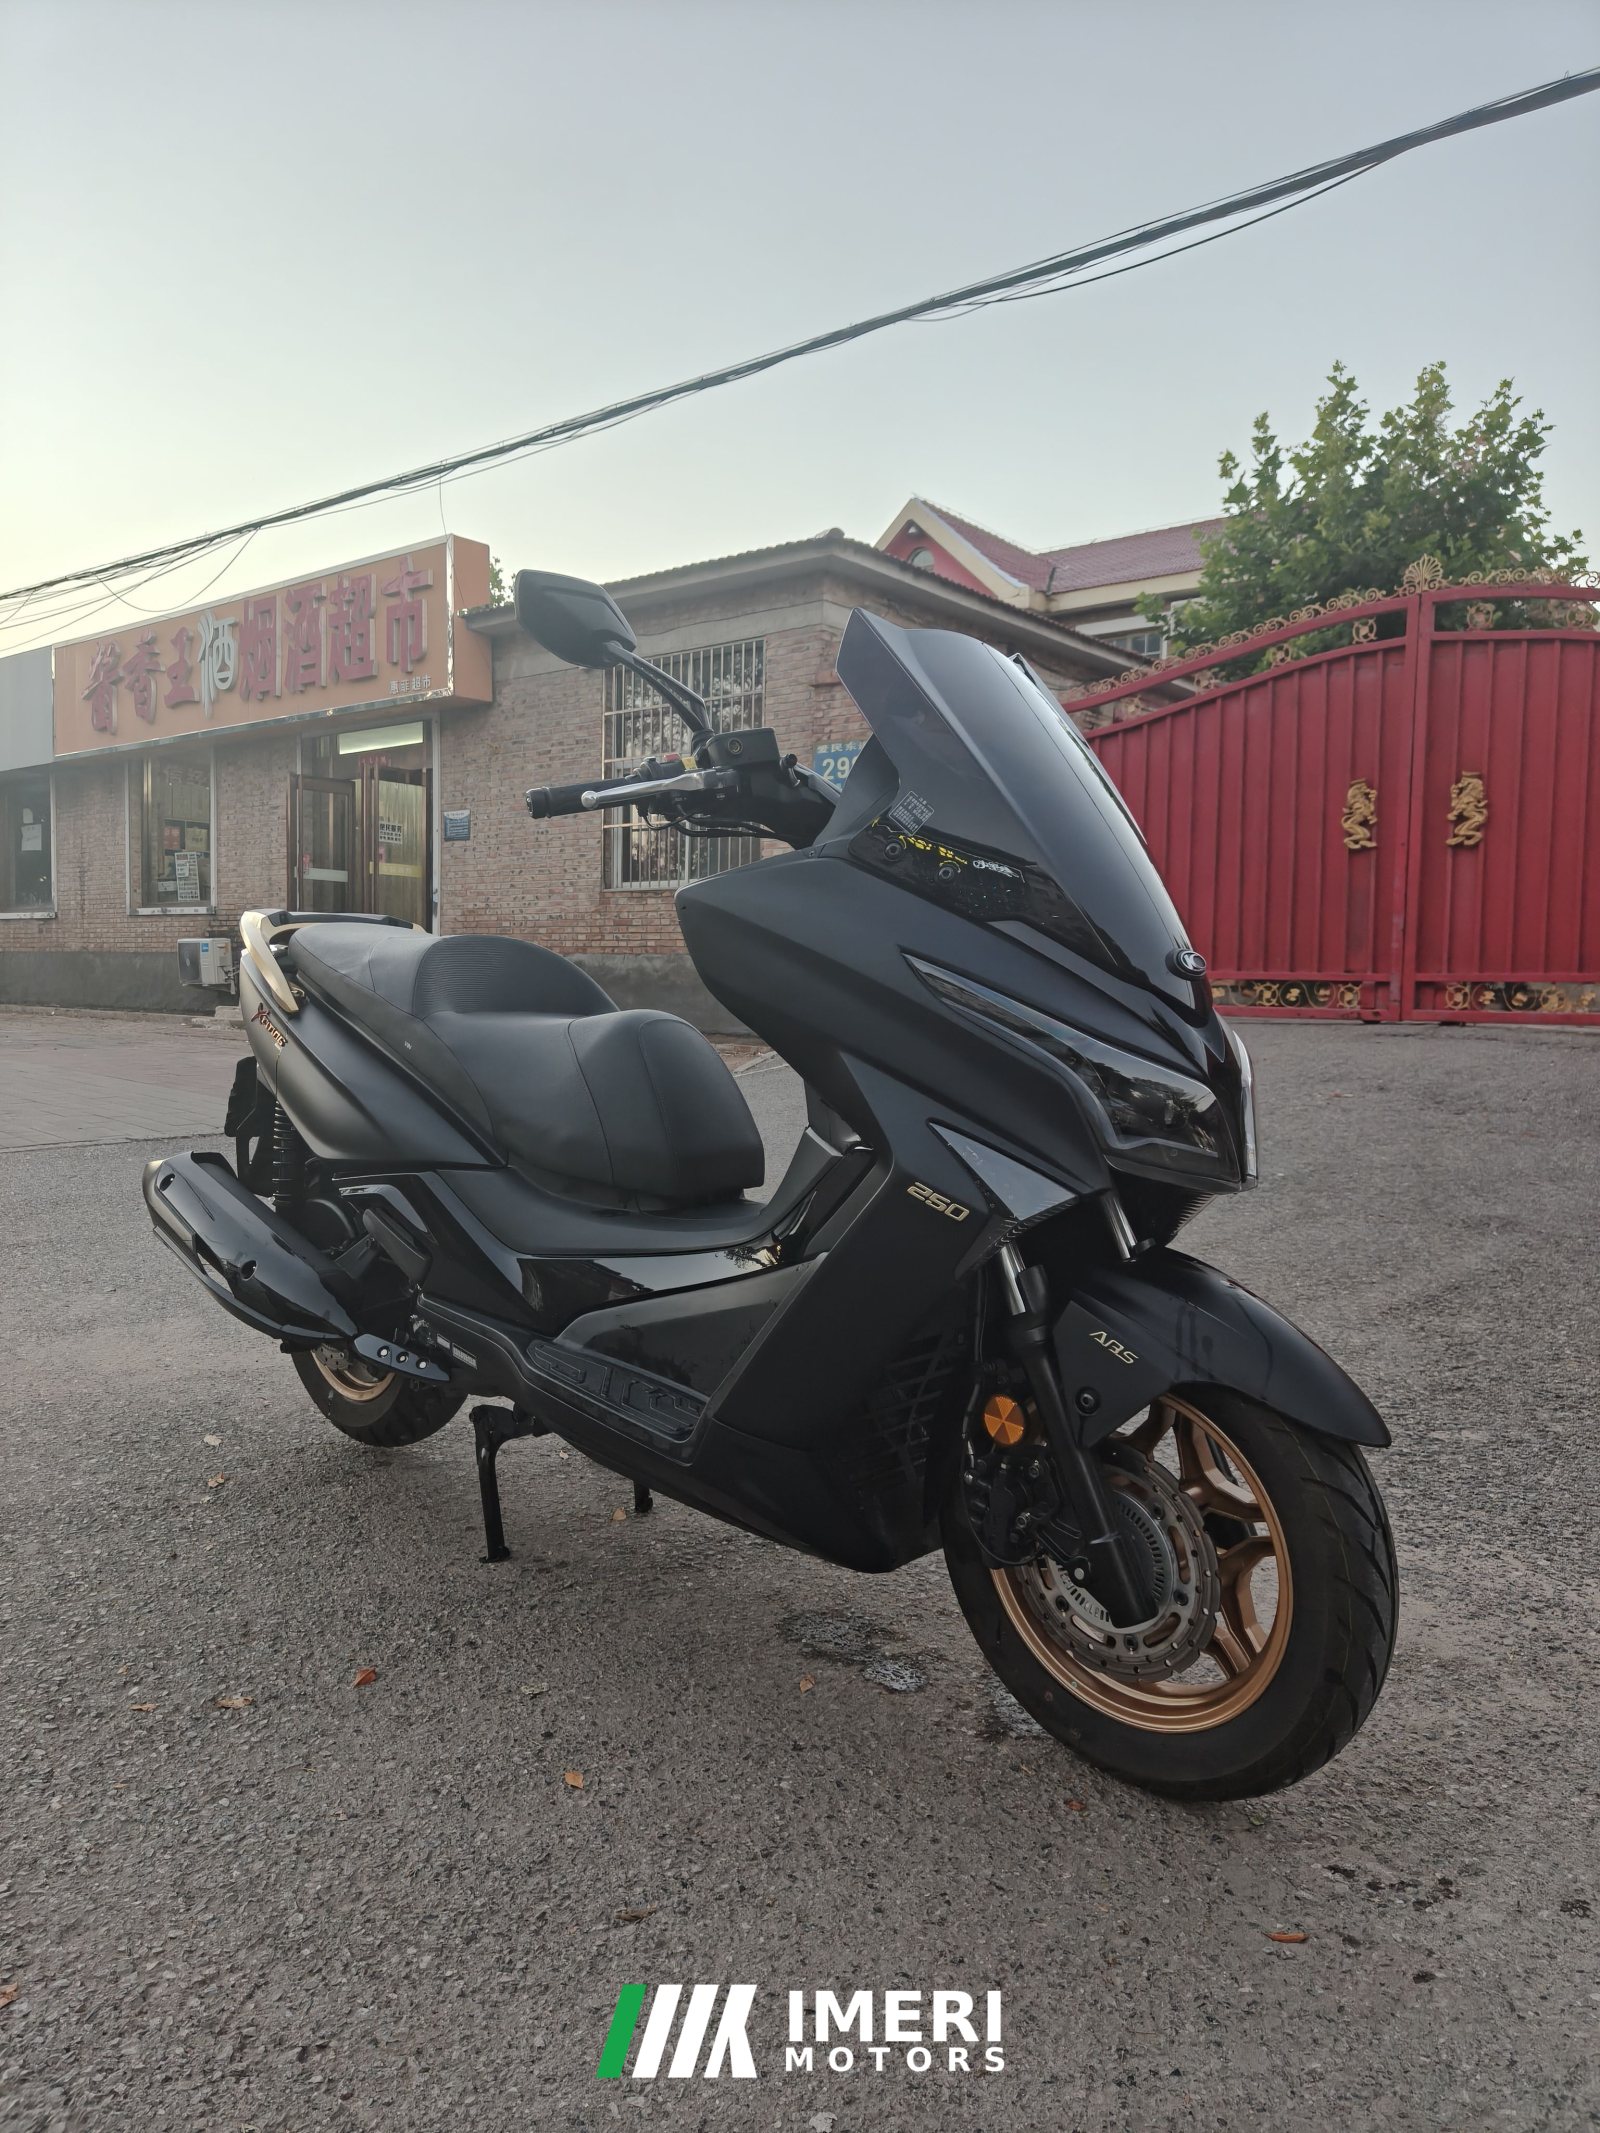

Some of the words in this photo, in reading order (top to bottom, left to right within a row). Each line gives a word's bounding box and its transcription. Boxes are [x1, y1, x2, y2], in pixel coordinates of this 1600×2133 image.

[822, 756, 858, 781] 29
[907, 1181, 970, 1222] 250
[1089, 1331, 1140, 1364] ABS
